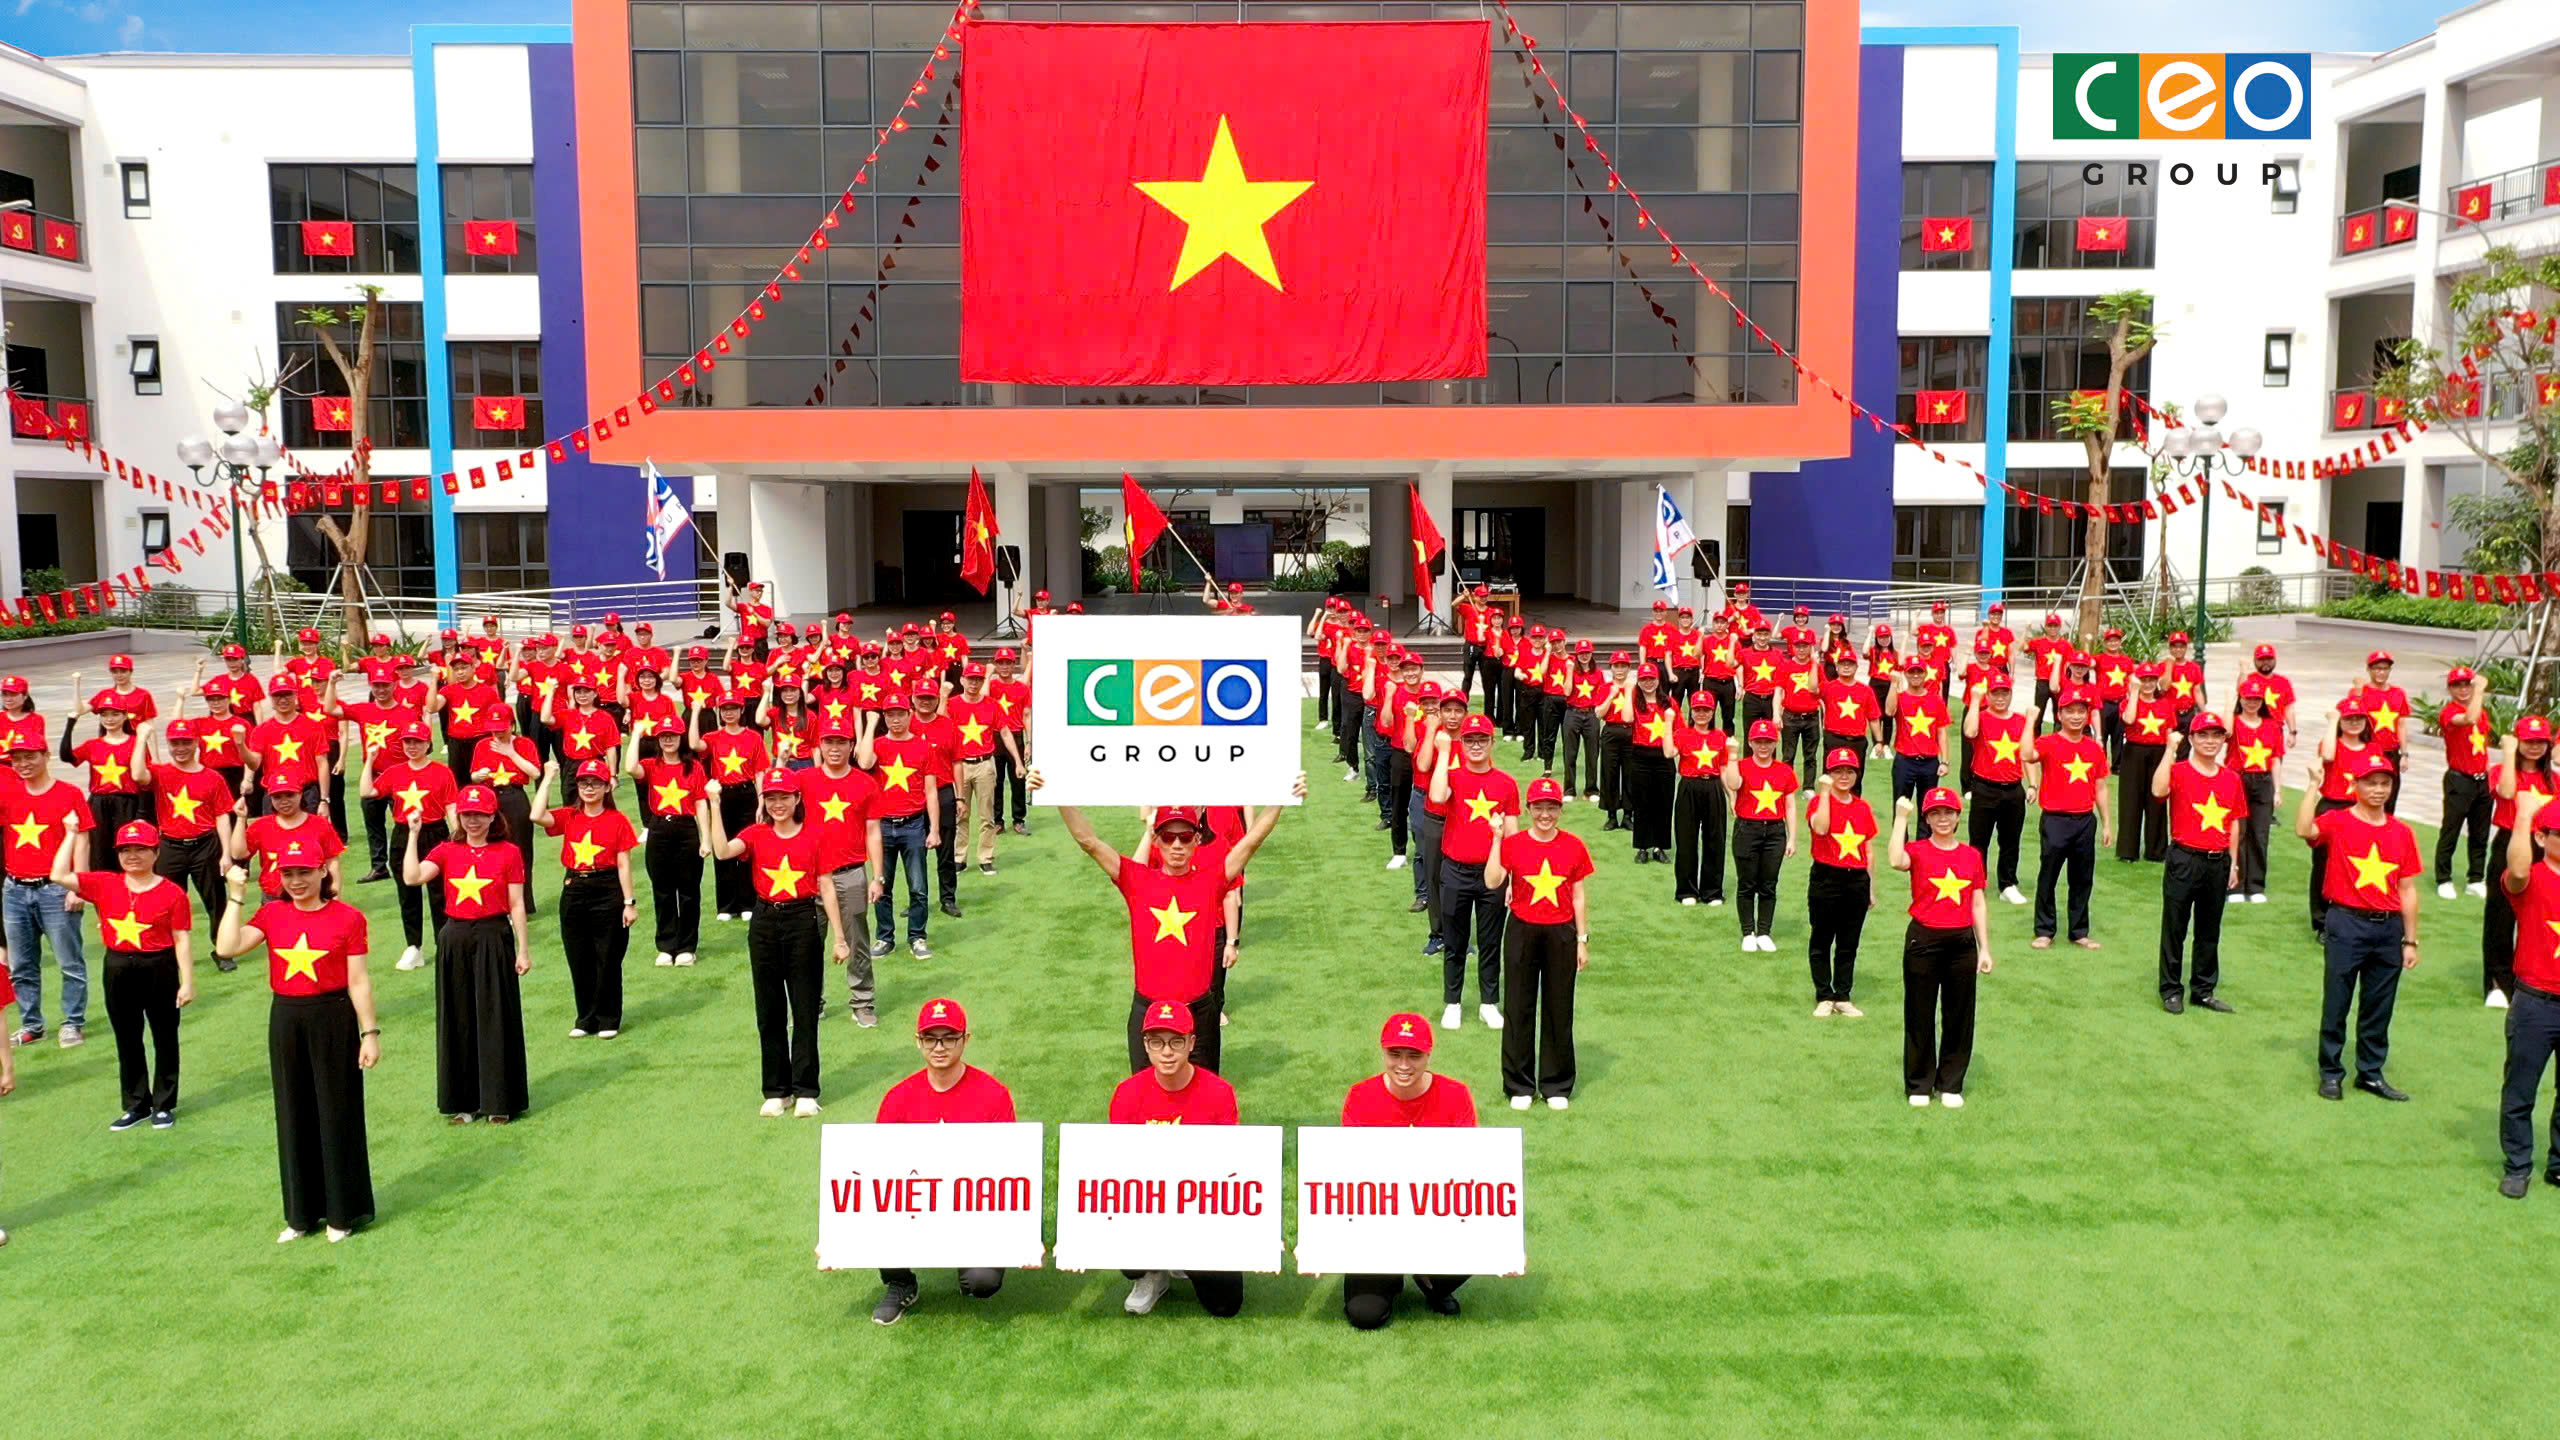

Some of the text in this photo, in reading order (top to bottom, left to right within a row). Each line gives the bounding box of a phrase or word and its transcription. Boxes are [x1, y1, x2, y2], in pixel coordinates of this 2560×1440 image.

[1090, 744, 1246, 763] GROUP
[830, 1169, 1031, 1220] VÌ VIỆT NAM
[1077, 1172, 1263, 1221] HẠNH PHÚC
[1304, 1178, 1517, 1223] THỊNH VƯỢNG
